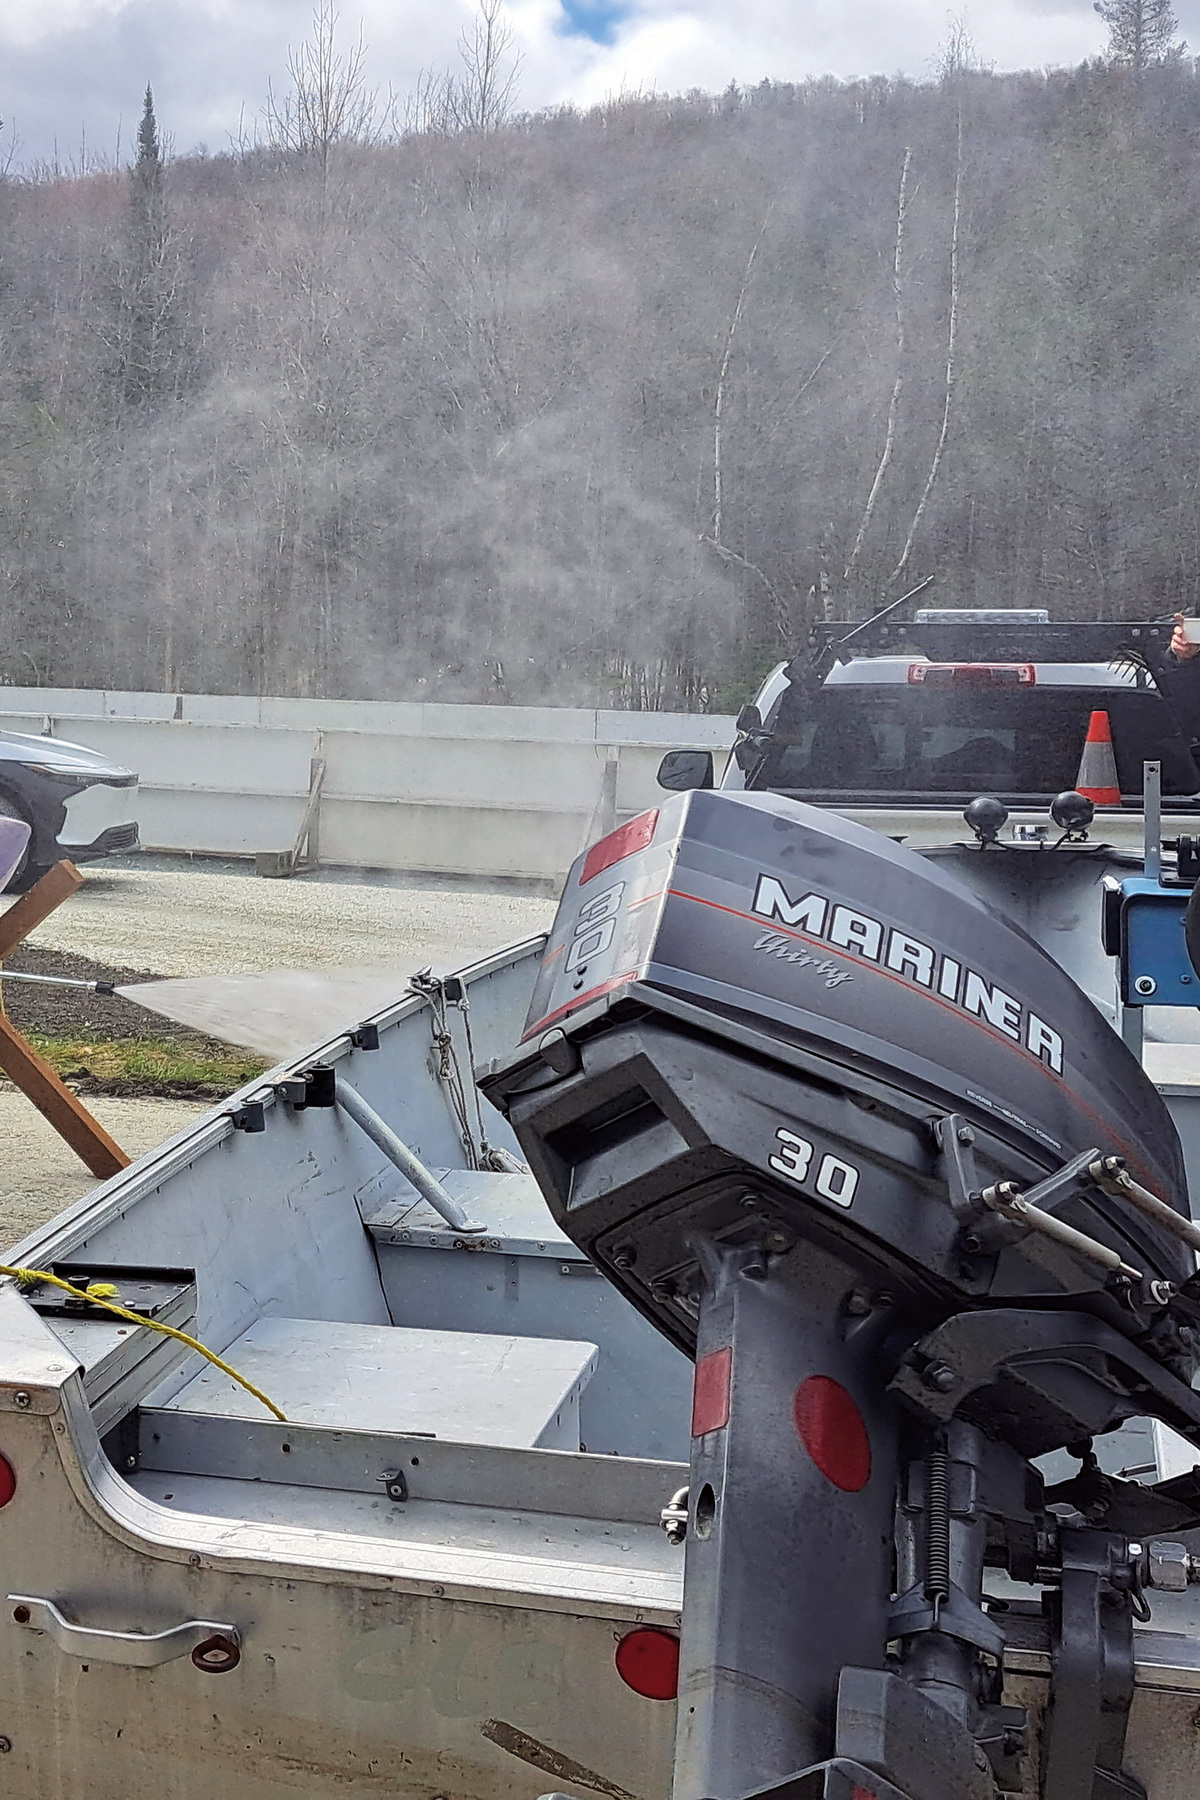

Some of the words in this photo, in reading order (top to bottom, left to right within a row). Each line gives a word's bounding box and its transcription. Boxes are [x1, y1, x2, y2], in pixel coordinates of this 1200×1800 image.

[564, 881, 626, 974] 30
[753, 929, 855, 989] Thirty
[751, 872, 1064, 1078] MARINER
[768, 1127, 860, 1210] 30
